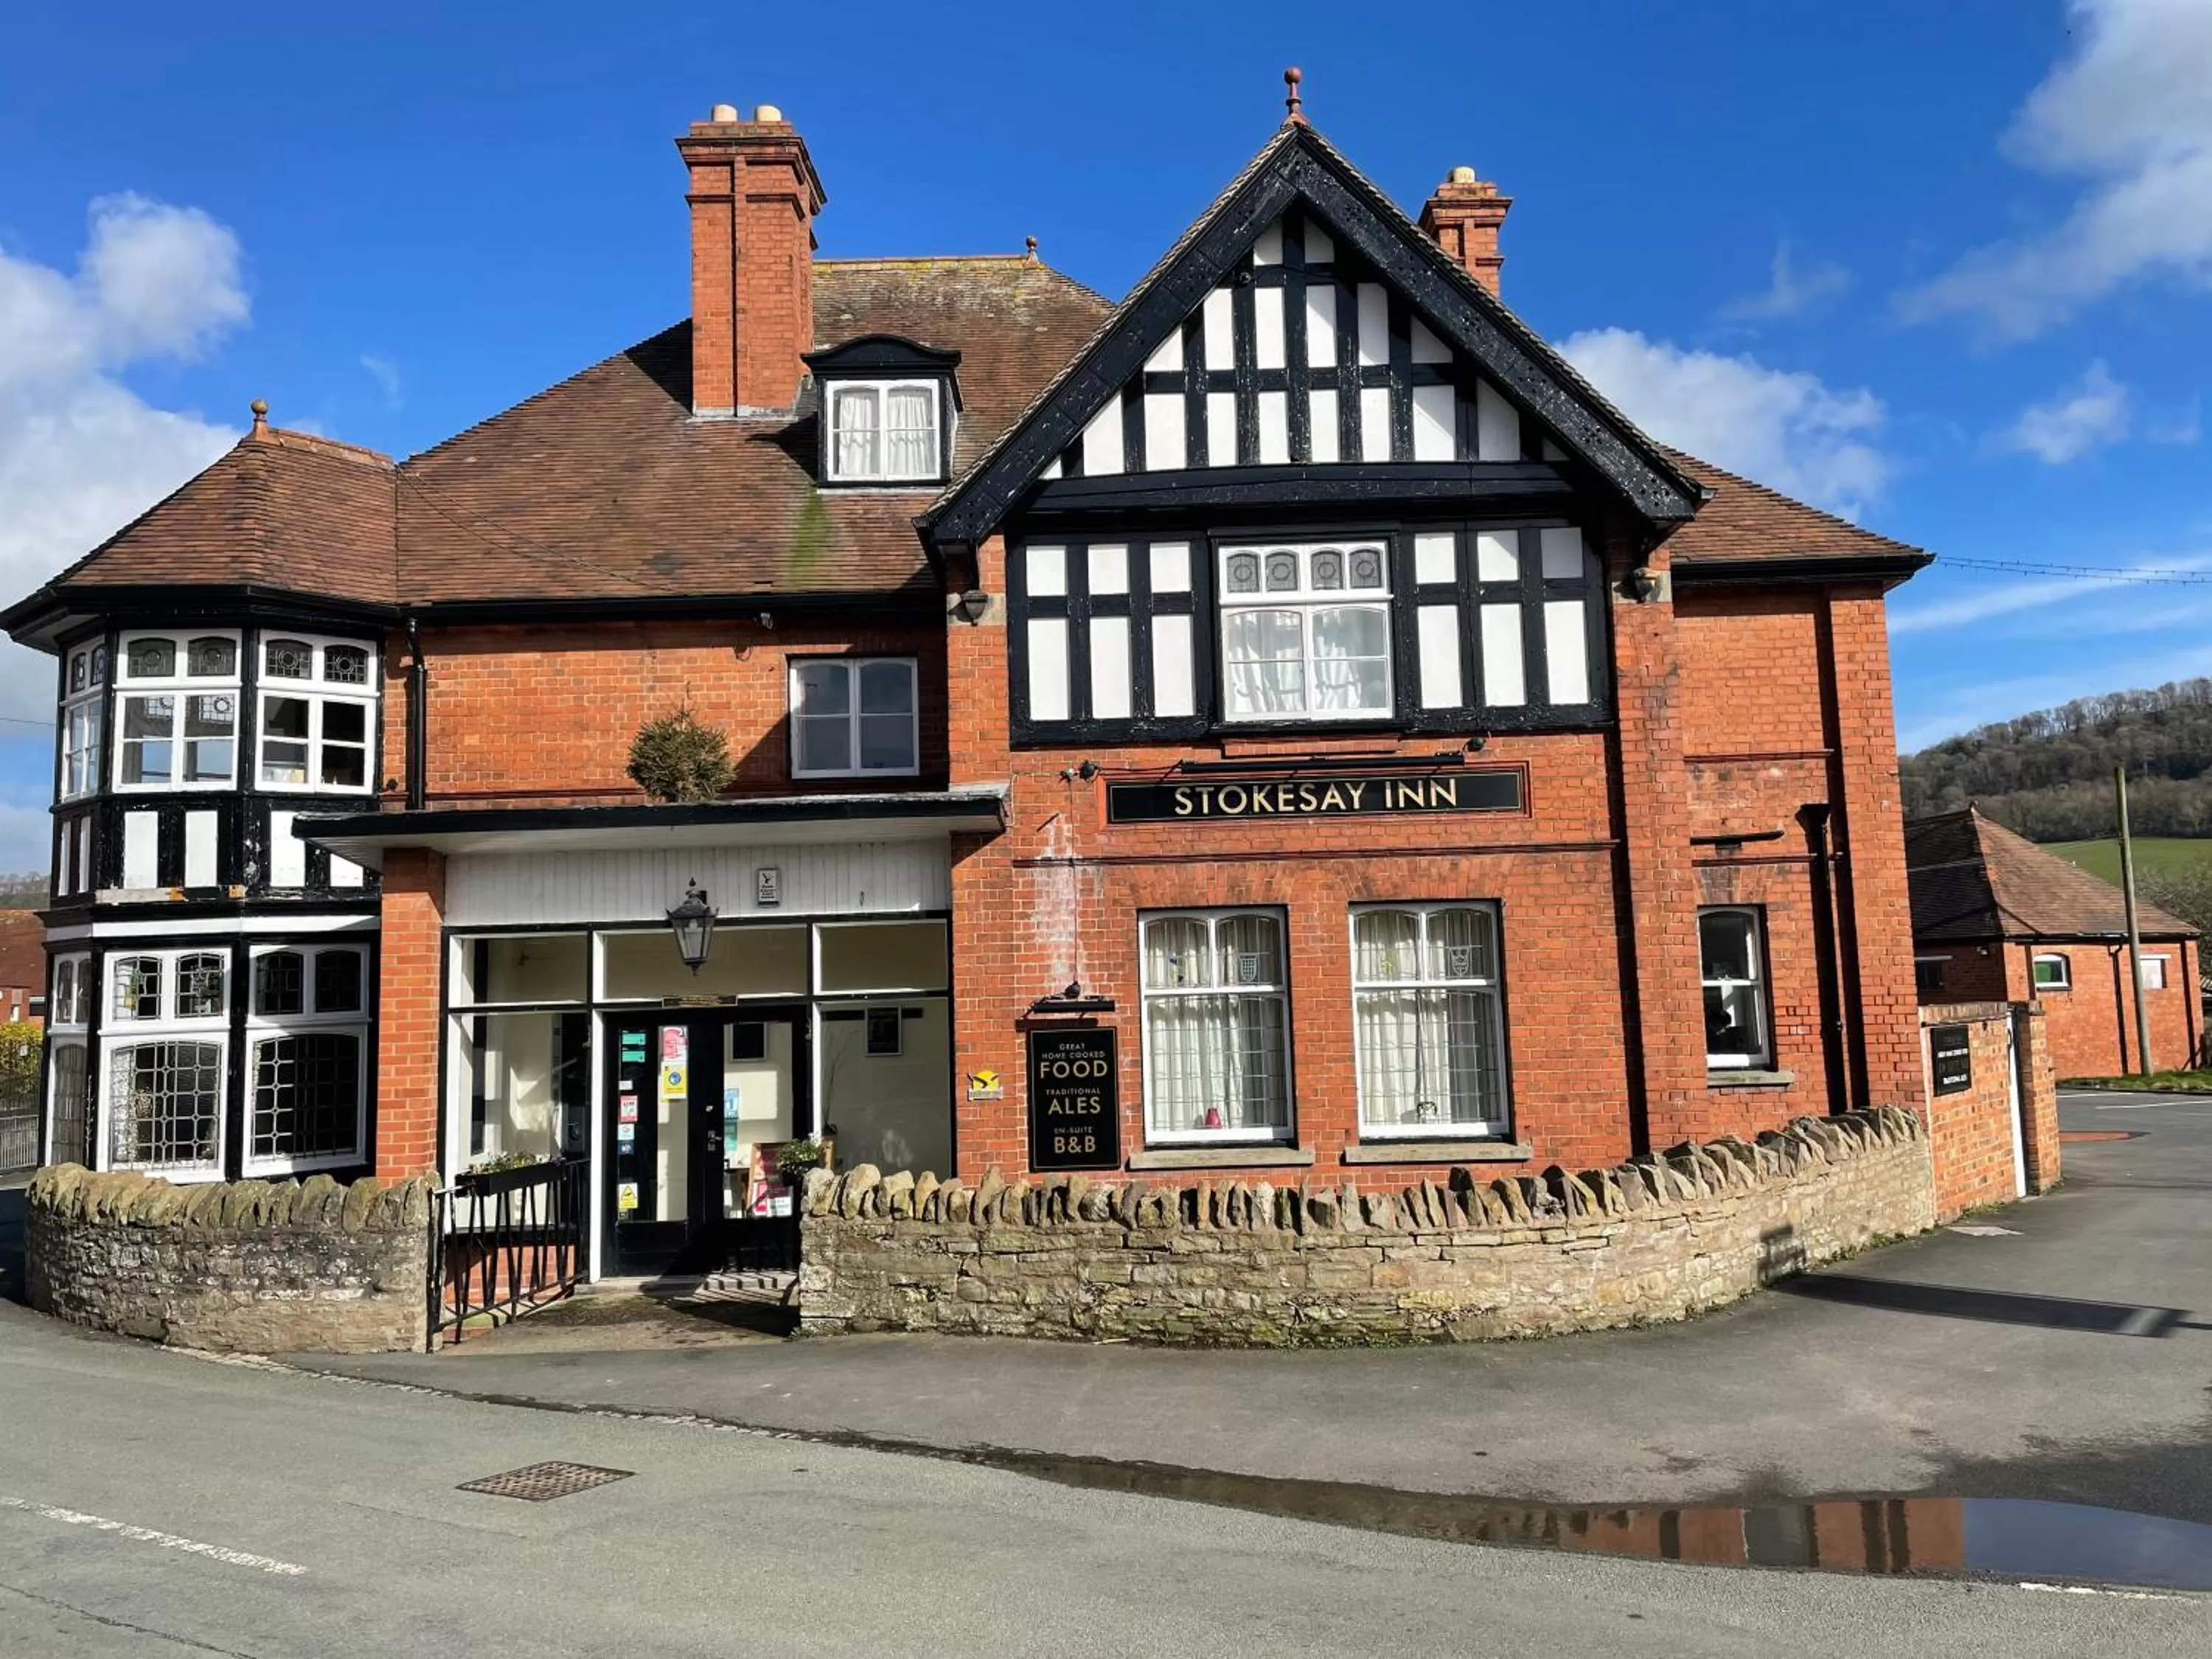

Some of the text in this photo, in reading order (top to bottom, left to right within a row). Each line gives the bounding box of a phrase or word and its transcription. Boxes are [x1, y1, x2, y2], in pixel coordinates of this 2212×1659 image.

[1174, 778, 1456, 815] STOKESAY INN
[1059, 1043, 1085, 1051] GREAT
[1069, 1051, 1105, 1059] COOKED
[1040, 1060, 1108, 1079] FOOD
[1046, 1087, 1101, 1096] TRADITIONAL
[1048, 1096, 1101, 1116] ALES
[1054, 1135, 1096, 1154] B&B
